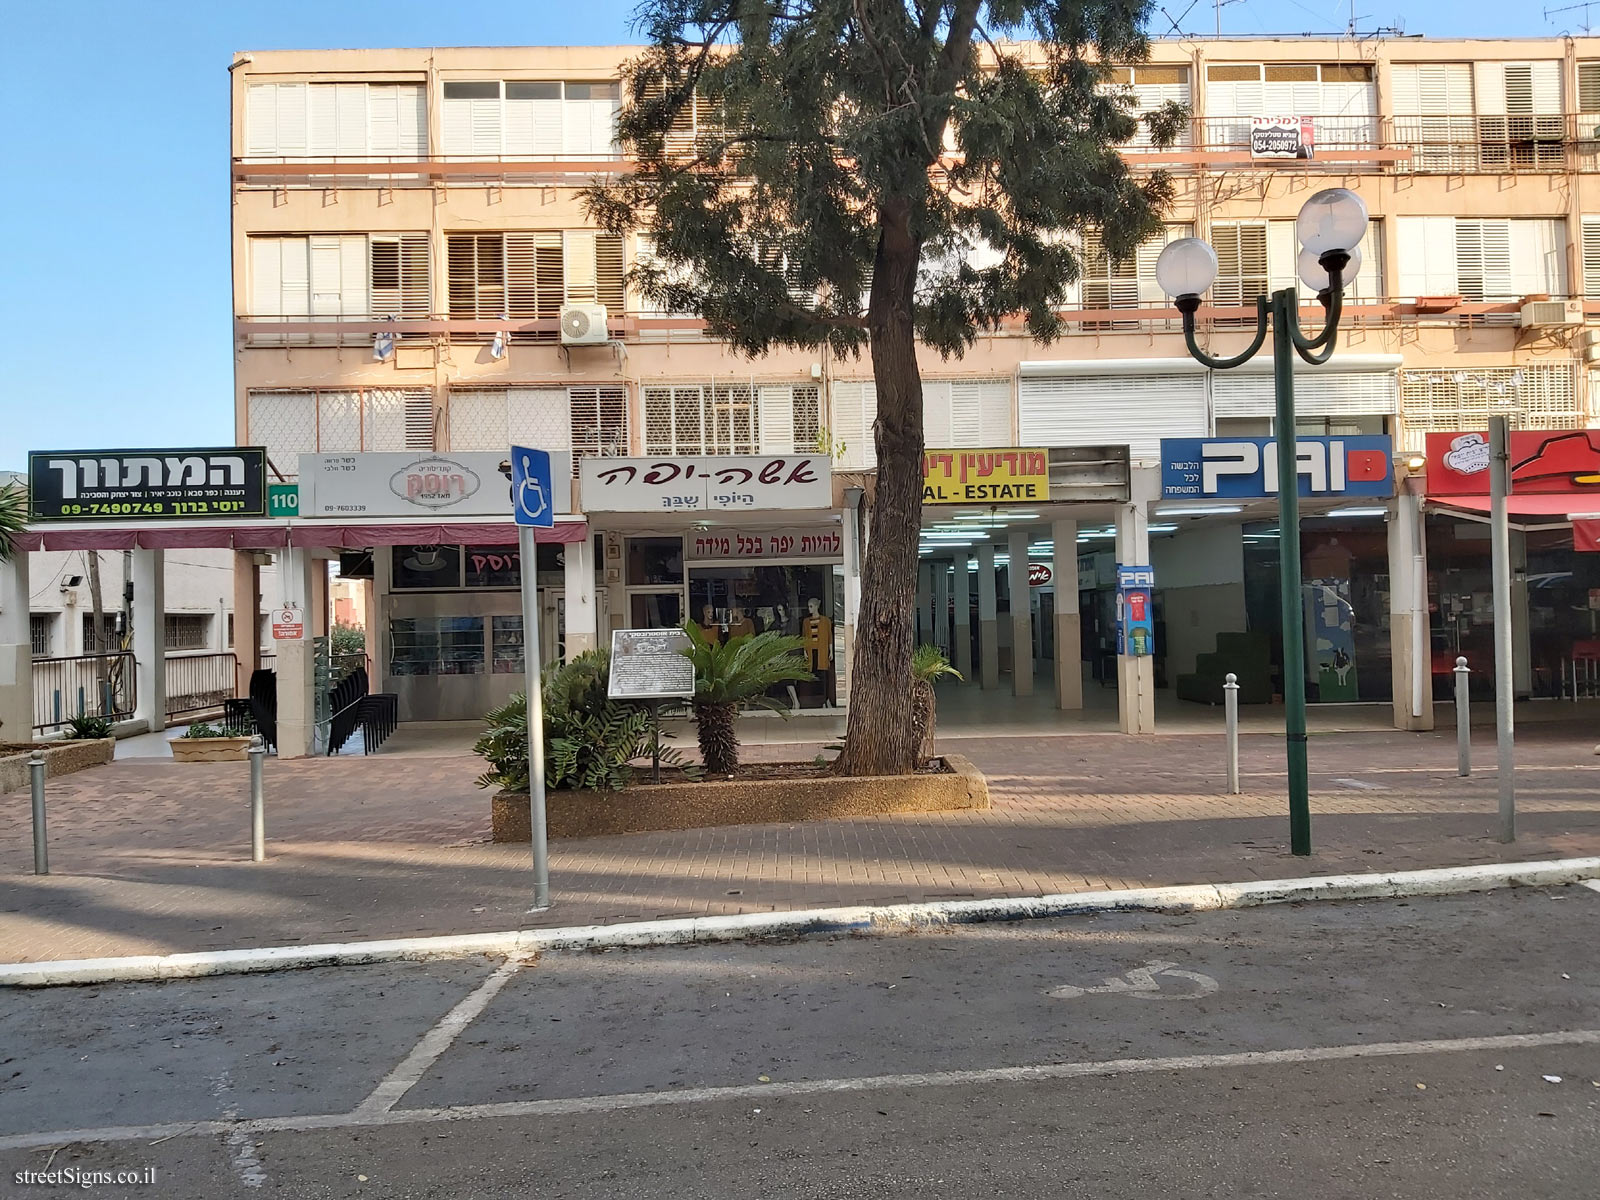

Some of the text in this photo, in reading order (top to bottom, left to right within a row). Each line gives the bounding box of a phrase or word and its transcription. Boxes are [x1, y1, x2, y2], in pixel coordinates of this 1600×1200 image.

[1253, 116, 1299, 125] למכירה
[1253, 140, 1297, 151] 054-2050972
[960, 452, 1046, 484] מודיעין
[1171, 462, 1199, 471] הלבשה
[49, 456, 245, 499] המתווך
[1184, 473, 1200, 482] לכל
[406, 474, 465, 498] רוסק
[965, 483, 1037, 499] ESTATE
[1165, 486, 1199, 494] המשפחה
[205, 490, 219, 498] כפר
[272, 493, 298, 509] 110
[61, 501, 245, 515] יוסי ברוך 09-7490749
[695, 531, 840, 555] להיות יפה בכל מידה
